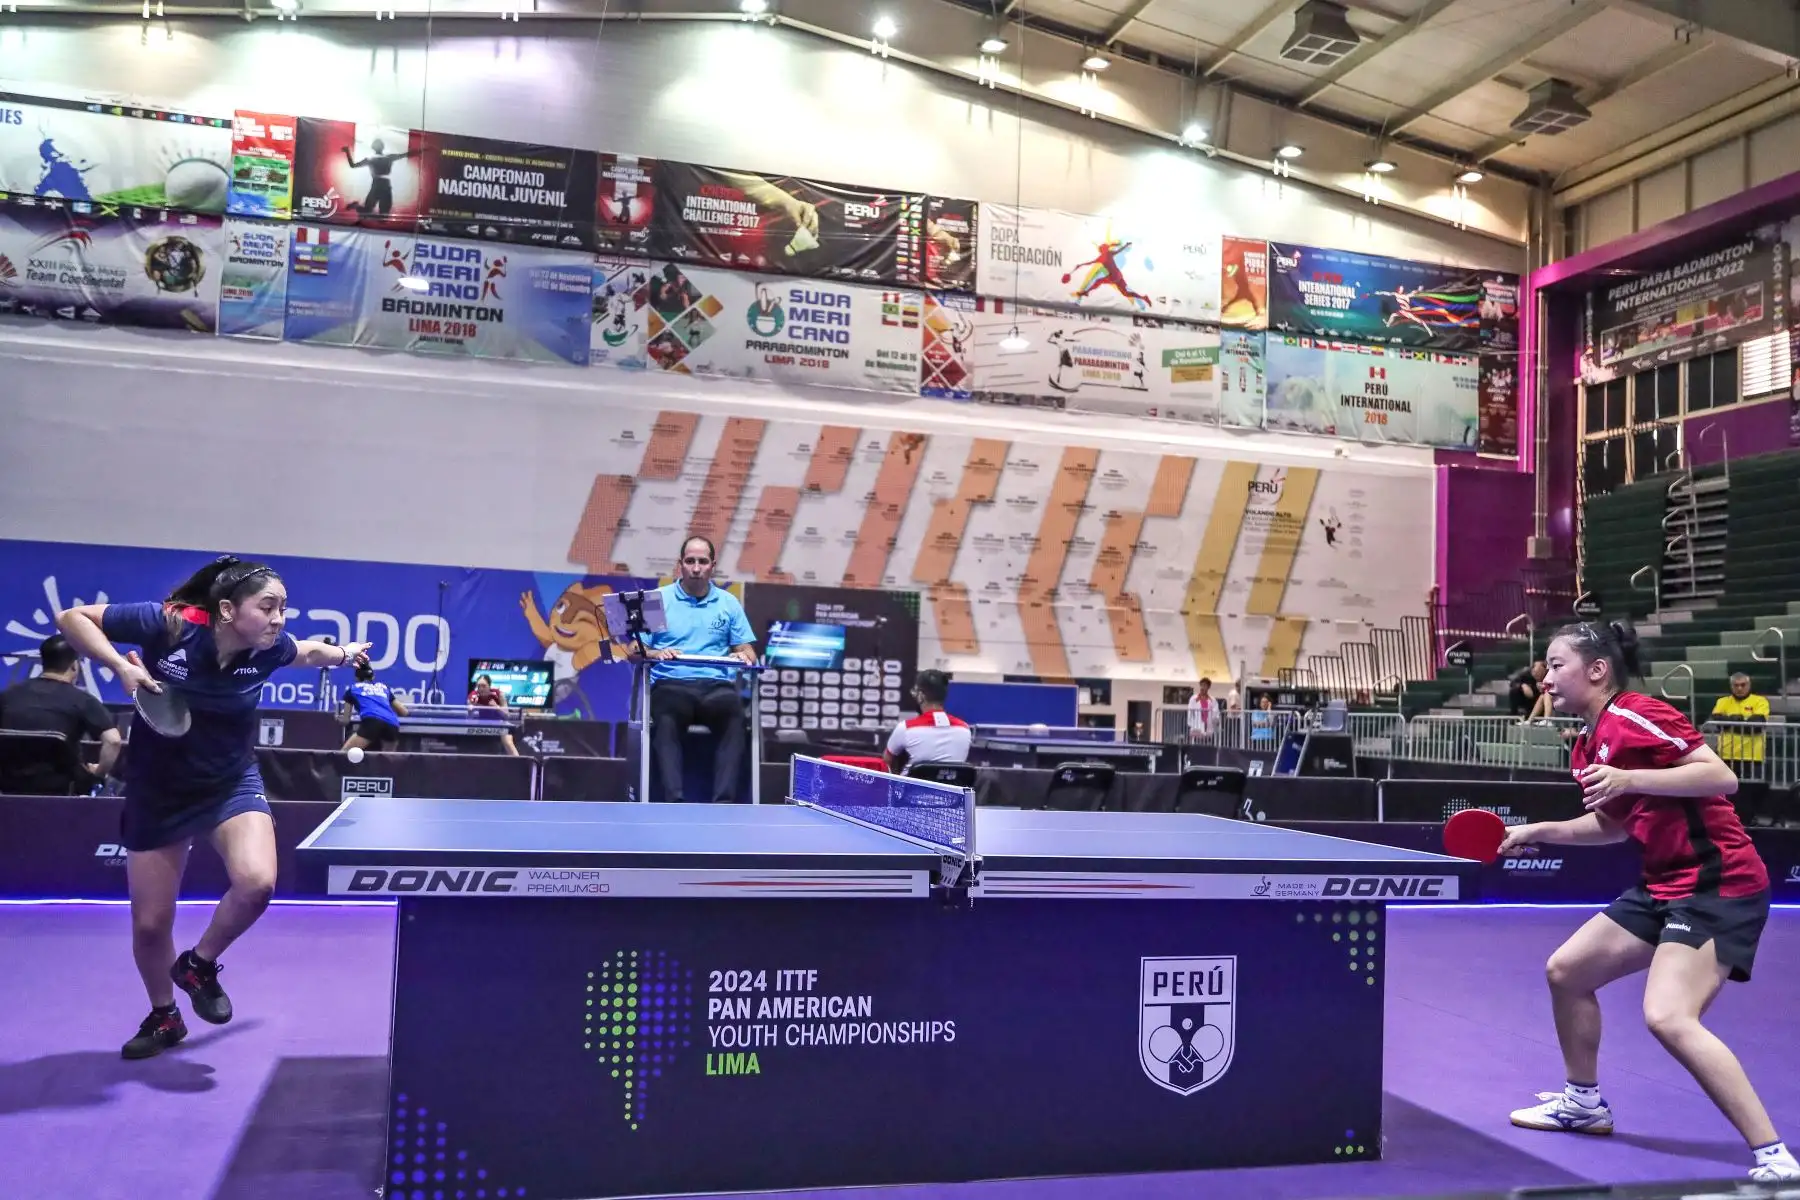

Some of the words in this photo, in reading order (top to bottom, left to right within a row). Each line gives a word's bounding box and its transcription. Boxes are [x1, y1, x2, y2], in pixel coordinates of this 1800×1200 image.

[463, 165, 545, 187] CAMPEONATO
[438, 178, 509, 201] NACIONAL
[510, 187, 568, 208] JUVENIL
[686, 195, 758, 215] INTERNATIONAL
[683, 208, 736, 225] CHALLENGE
[737, 215, 760, 228] 2017
[991, 226, 1020, 244] COPA
[414, 243, 482, 264] SUDA
[991, 243, 1063, 268] FEDERACIÓN
[27, 268, 57, 282] Team
[411, 261, 481, 282] MERI
[1608, 280, 1639, 301] PERU
[1639, 269, 1672, 290] PARA
[1672, 240, 1754, 279] BADMINTON
[1299, 280, 1356, 299] INTERNATIONAL
[1615, 271, 1713, 312] INTERNATIONAL
[1713, 259, 1745, 280] 2022
[789, 289, 852, 309] SUDA
[1304, 293, 1331, 307] SERIES
[1332, 297, 1351, 310] 2017
[788, 307, 850, 326] MERI
[409, 317, 441, 334] LIMA
[443, 320, 477, 338] 2018
[788, 325, 850, 344] CANO
[745, 339, 850, 360] PARABADMINTON
[764, 354, 796, 366] LIMA
[799, 358, 830, 369] 2018
[1074, 357, 1131, 371] PARABADMINTON
[1340, 394, 1412, 413] INTERNATIONAL
[1364, 411, 1388, 425] 2018
[159, 659, 189, 673] COMPLEJO
[943, 854, 962, 868] DONIC
[1503, 859, 1563, 870] DONIC
[347, 869, 518, 892] DONIC
[528, 871, 600, 880] WALDNER
[1321, 877, 1444, 897] DONIC
[708, 970, 768, 992] 2024
[776, 969, 818, 992] ITTF
[1153, 965, 1223, 997] PERÚ
[707, 997, 751, 1020] PAN
[756, 995, 872, 1019] AMERICAN
[708, 1024, 778, 1047] YOUTH
[785, 1020, 956, 1046] CHAMPIONSHIPS
[706, 1052, 761, 1076] LIMA
